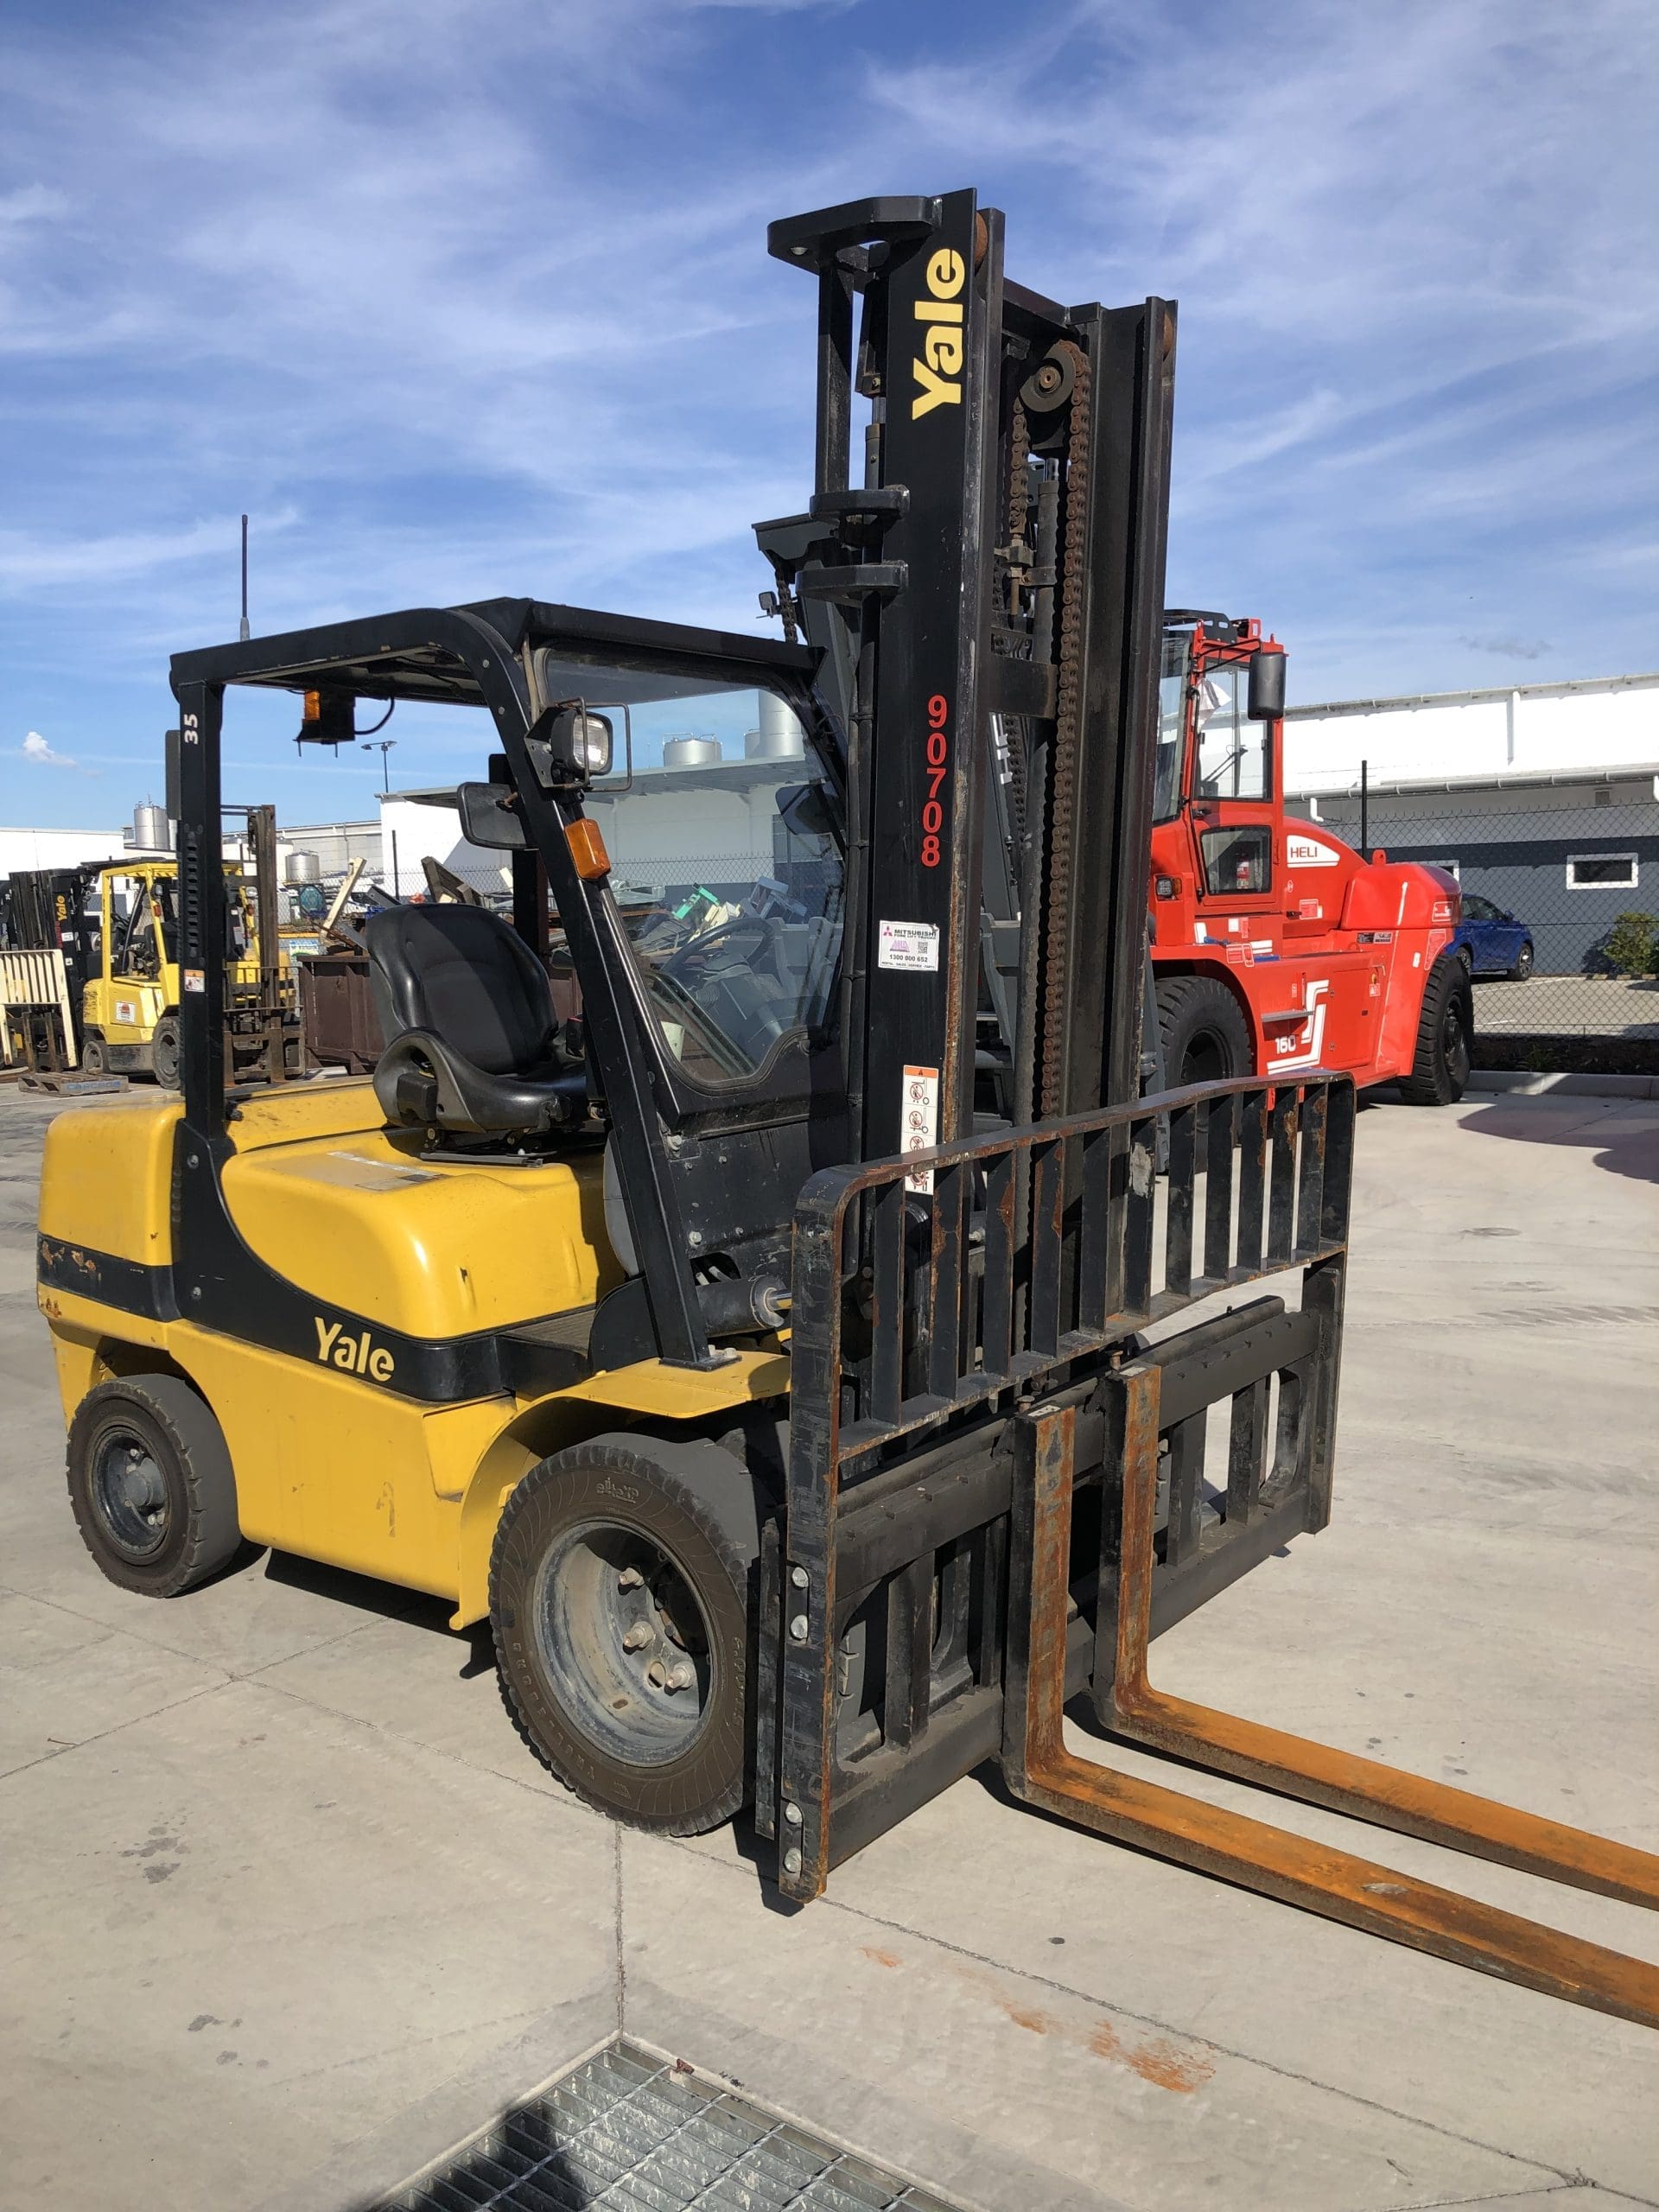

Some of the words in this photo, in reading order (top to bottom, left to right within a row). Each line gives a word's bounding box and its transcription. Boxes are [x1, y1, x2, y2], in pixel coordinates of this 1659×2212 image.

[912, 248, 965, 421] Yale
[184, 713, 199, 745] 35
[921, 695, 947, 868] 90708
[1290, 846, 1318, 858] HELI
[1274, 1035, 1297, 1054] 160
[314, 1317, 395, 1382] Yale
